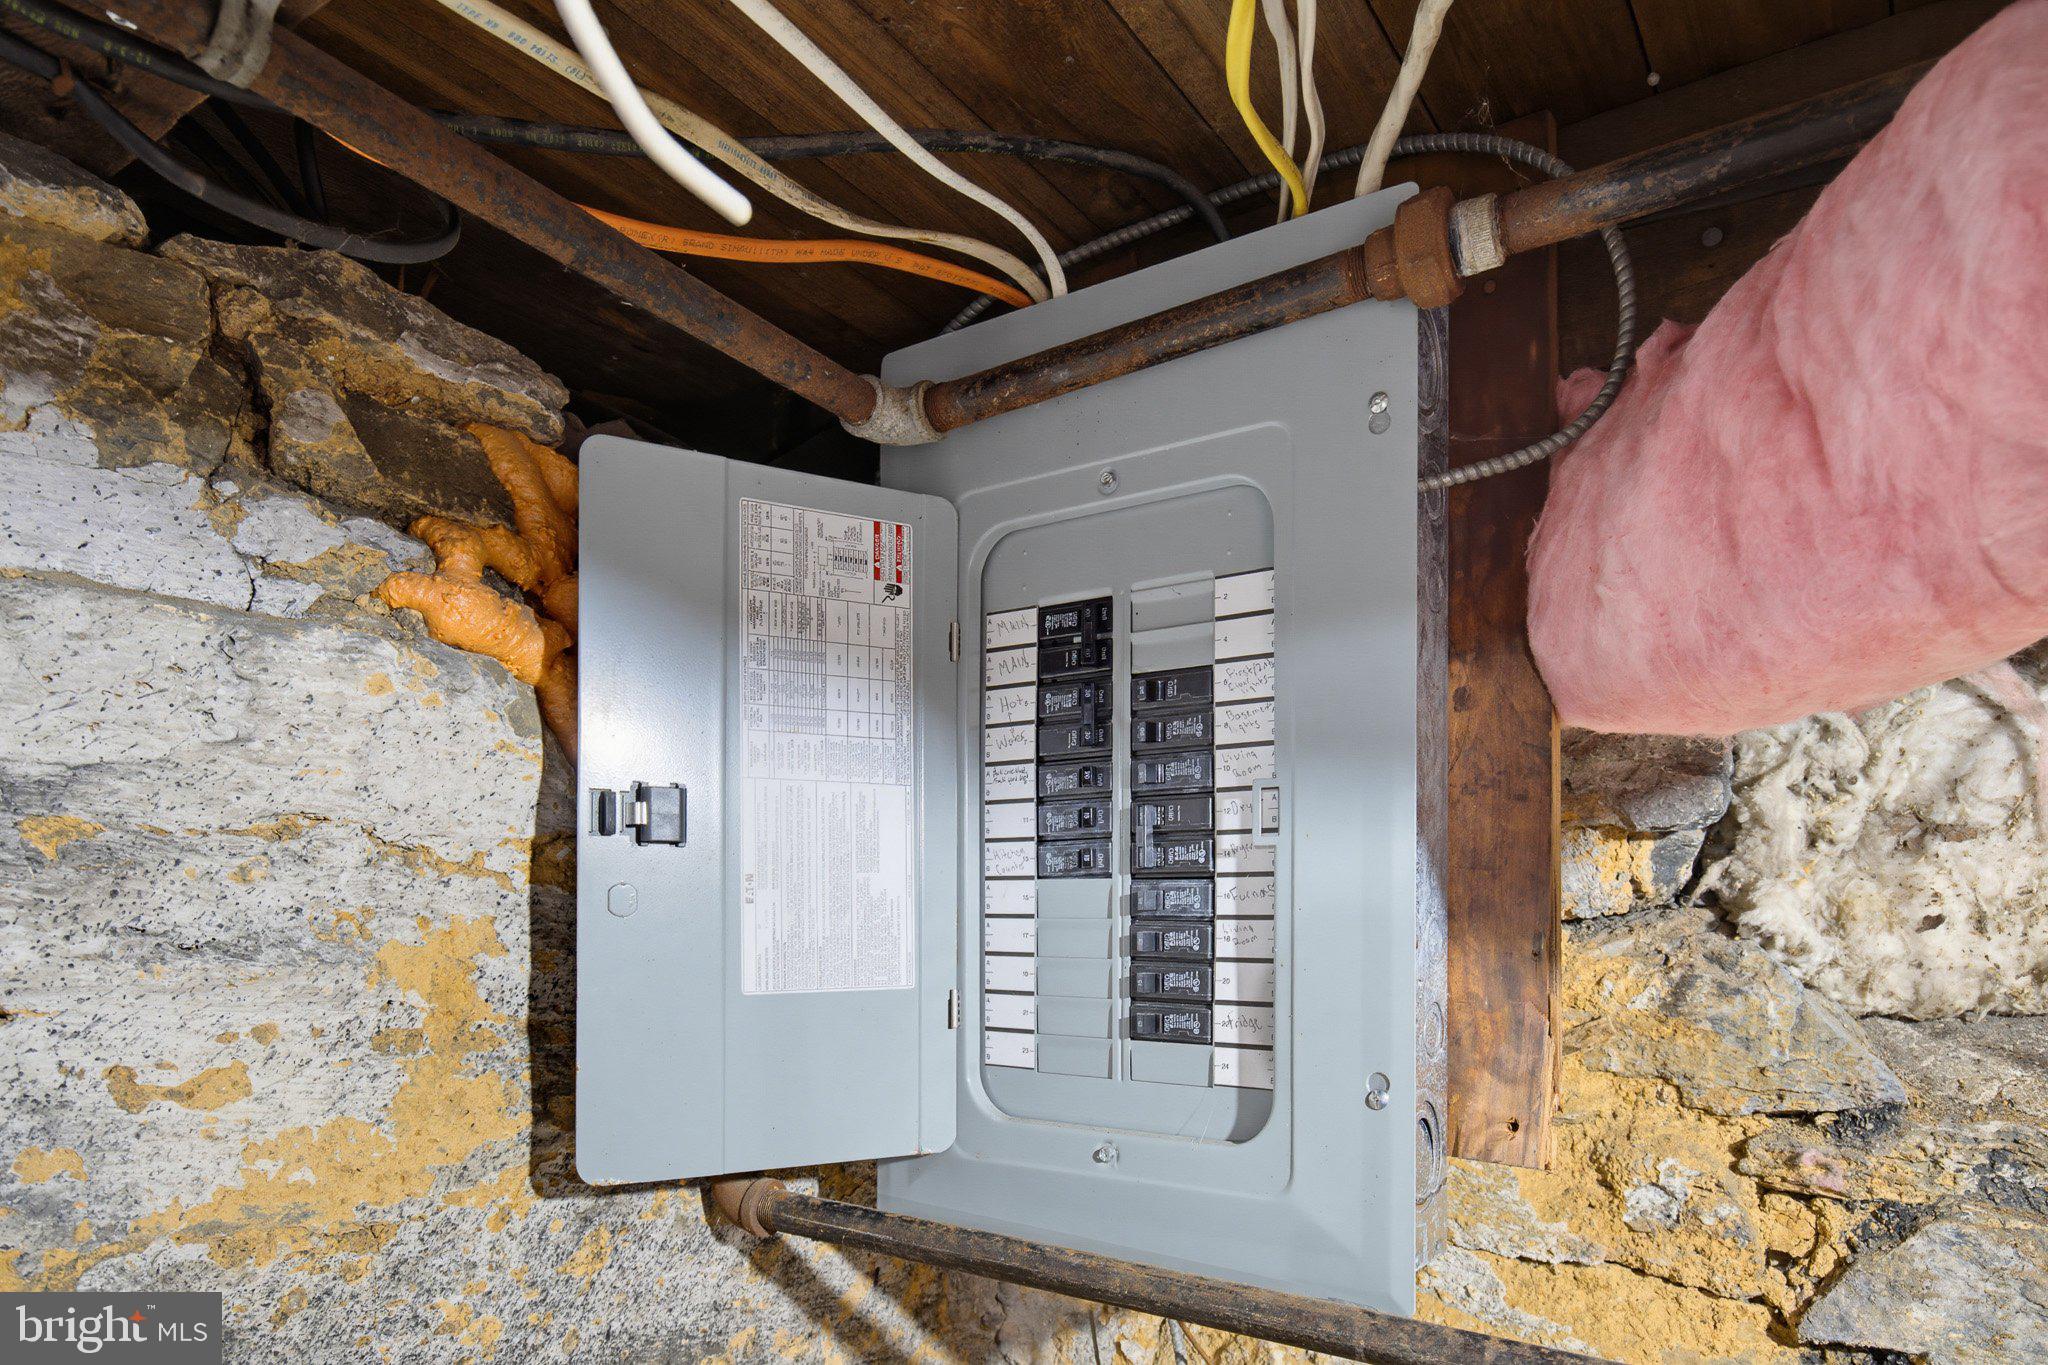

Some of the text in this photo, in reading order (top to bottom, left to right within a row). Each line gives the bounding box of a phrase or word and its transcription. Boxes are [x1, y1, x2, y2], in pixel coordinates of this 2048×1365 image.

[997, 614, 1029, 637] MAIN
[998, 654, 1027, 676] MAIN
[1000, 695, 1023, 713] Hot
[1226, 703, 1272, 721] Basement
[1222, 751, 1257, 763] Living
[1233, 764, 1262, 777] Room
